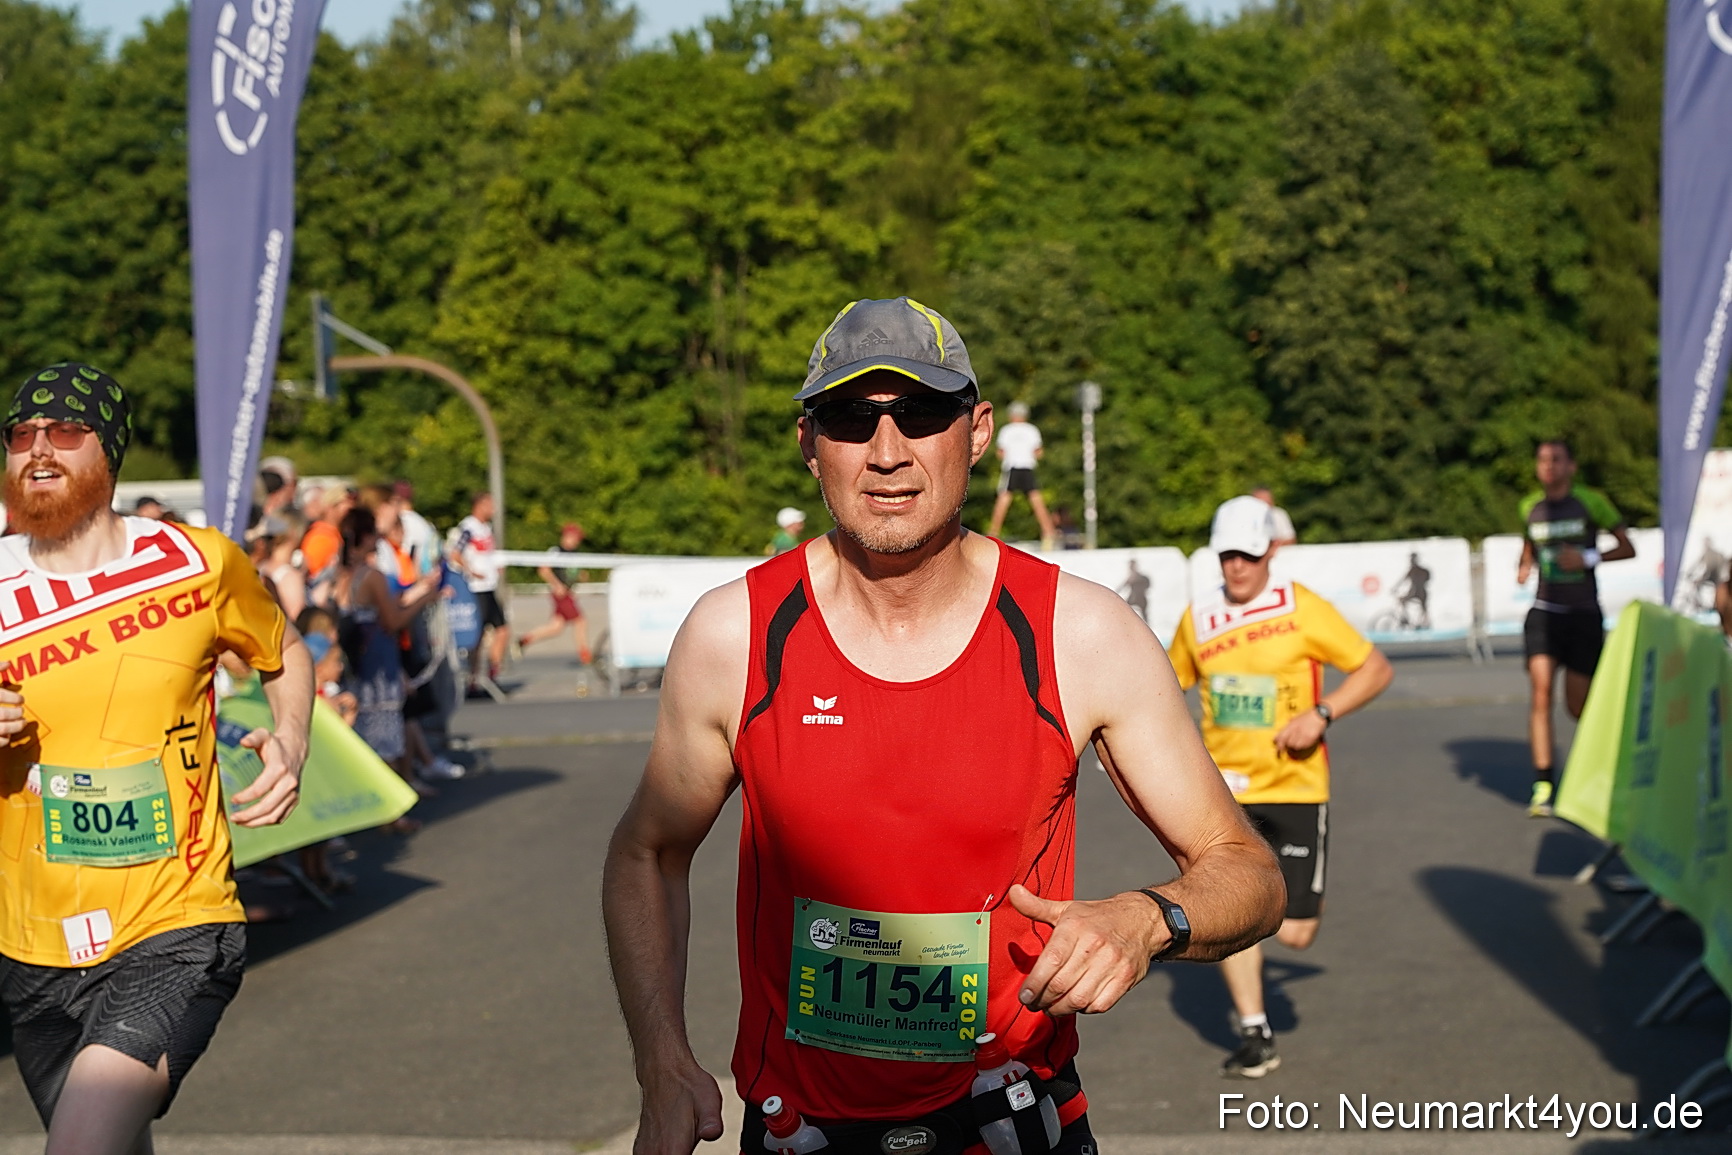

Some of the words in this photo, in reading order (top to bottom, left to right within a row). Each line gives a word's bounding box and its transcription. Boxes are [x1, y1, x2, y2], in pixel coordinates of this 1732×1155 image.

[232, 0, 276, 111] Fisc
[265, 0, 295, 98] AUTOM
[108, 589, 210, 643] BÖGL
[802, 713, 844, 725] erima
[49, 809, 63, 844] RUN
[72, 800, 139, 833] 804
[152, 798, 169, 845] 2022
[63, 833, 107, 847] Rosanski
[110, 832, 156, 847] Valentin
[840, 936, 902, 950] Firmenlauf
[863, 949, 900, 957] neumarkt
[799, 966, 817, 1016] RUN
[822, 957, 956, 1013] 1154
[814, 1003, 890, 1029] Neumüller
[895, 1017, 958, 1032] Manfred
[959, 973, 978, 1041] 2022
[826, 1028, 857, 1040] Sparkasse
[857, 1035, 887, 1045] Neumarkt
